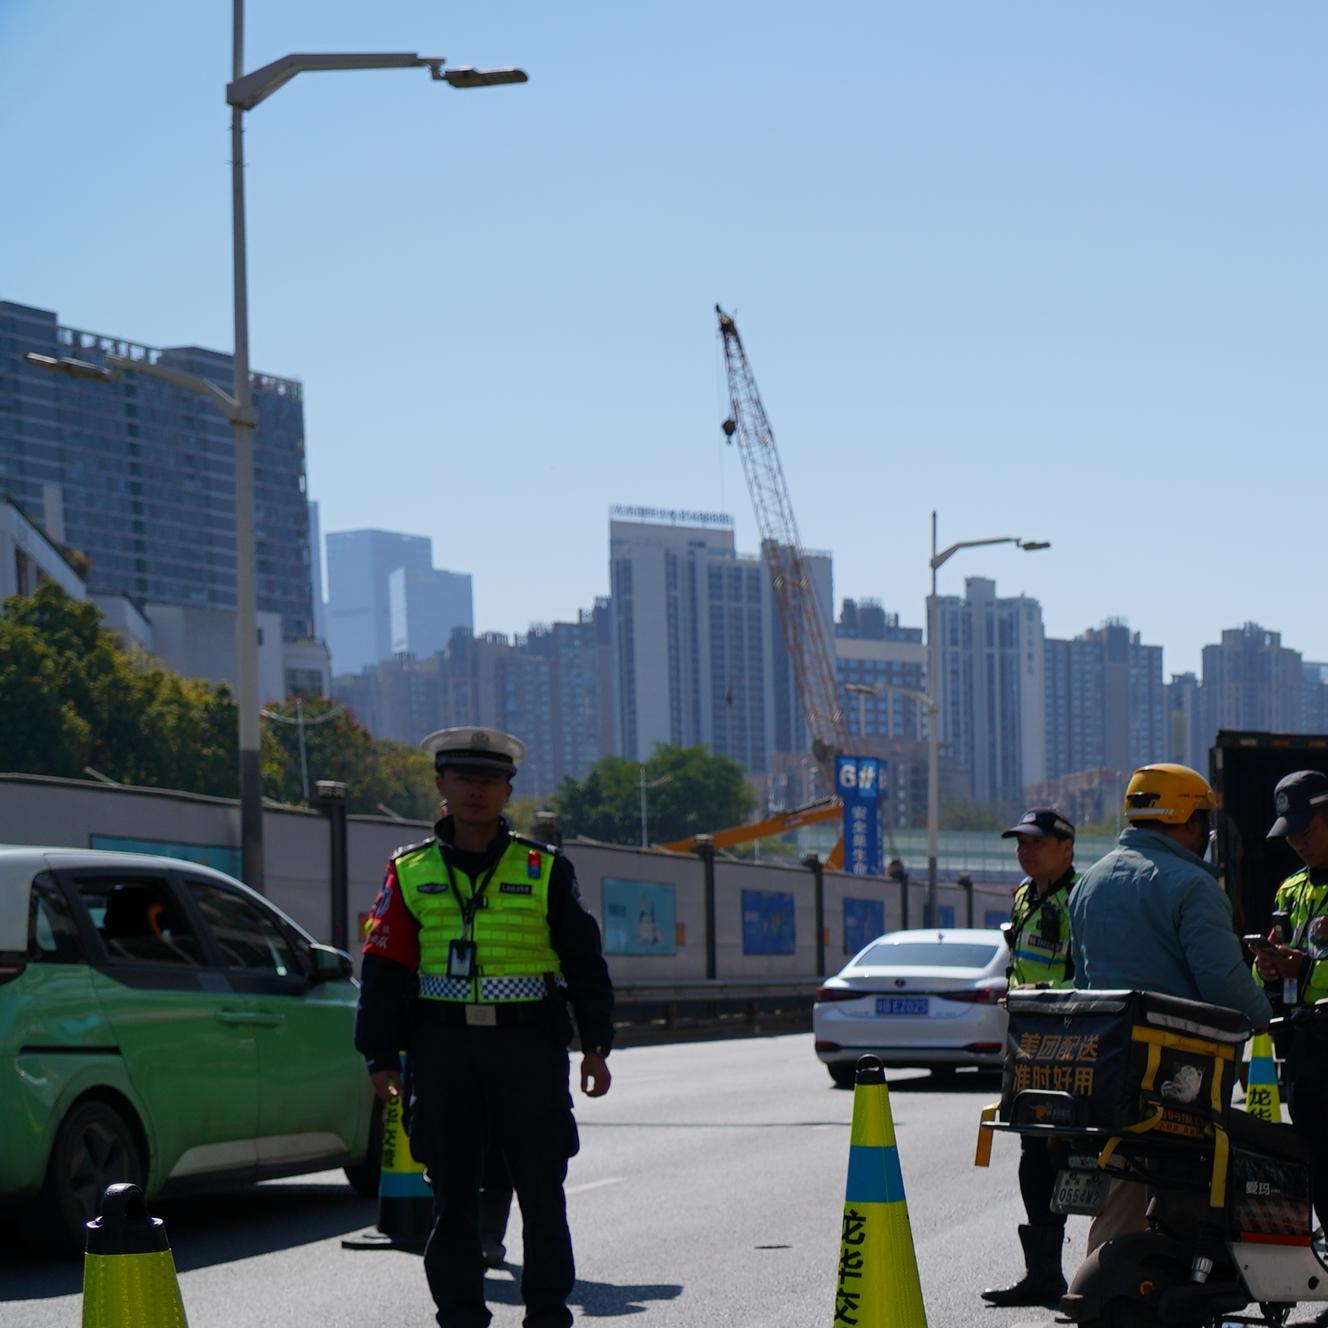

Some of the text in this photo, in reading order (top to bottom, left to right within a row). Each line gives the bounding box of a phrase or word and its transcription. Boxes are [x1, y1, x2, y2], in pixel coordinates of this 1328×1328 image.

[839, 764, 876, 789] 6#
[1013, 1032, 1100, 1060] 美团配送
[1012, 1064, 1094, 1096] 准时好用
